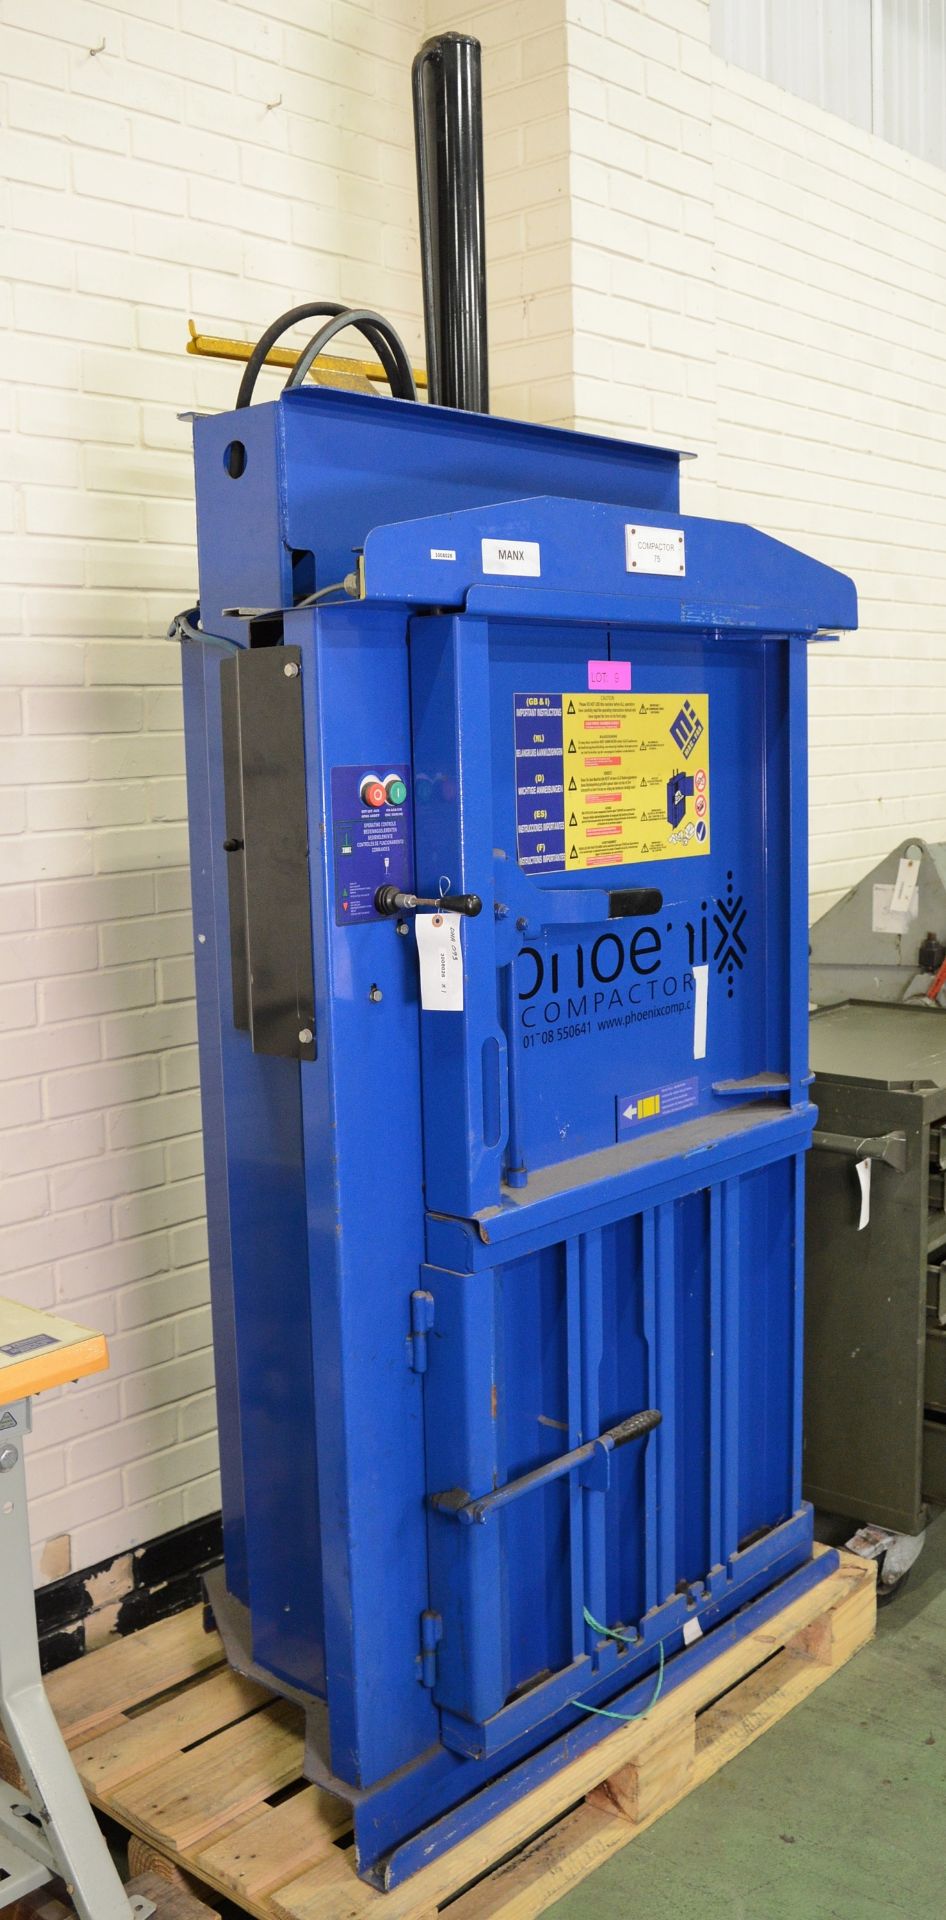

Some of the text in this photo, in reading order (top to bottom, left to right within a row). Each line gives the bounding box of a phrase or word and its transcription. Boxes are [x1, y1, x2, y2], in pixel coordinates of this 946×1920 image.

[637, 541, 675, 552] COMPACTOR
[498, 549, 525, 561] MANX
[535, 774, 545, 784] (D)
[533, 810, 547, 820] (ES)
[523, 1030, 554, 1049] 0108
[557, 1022, 591, 1042] 550641
